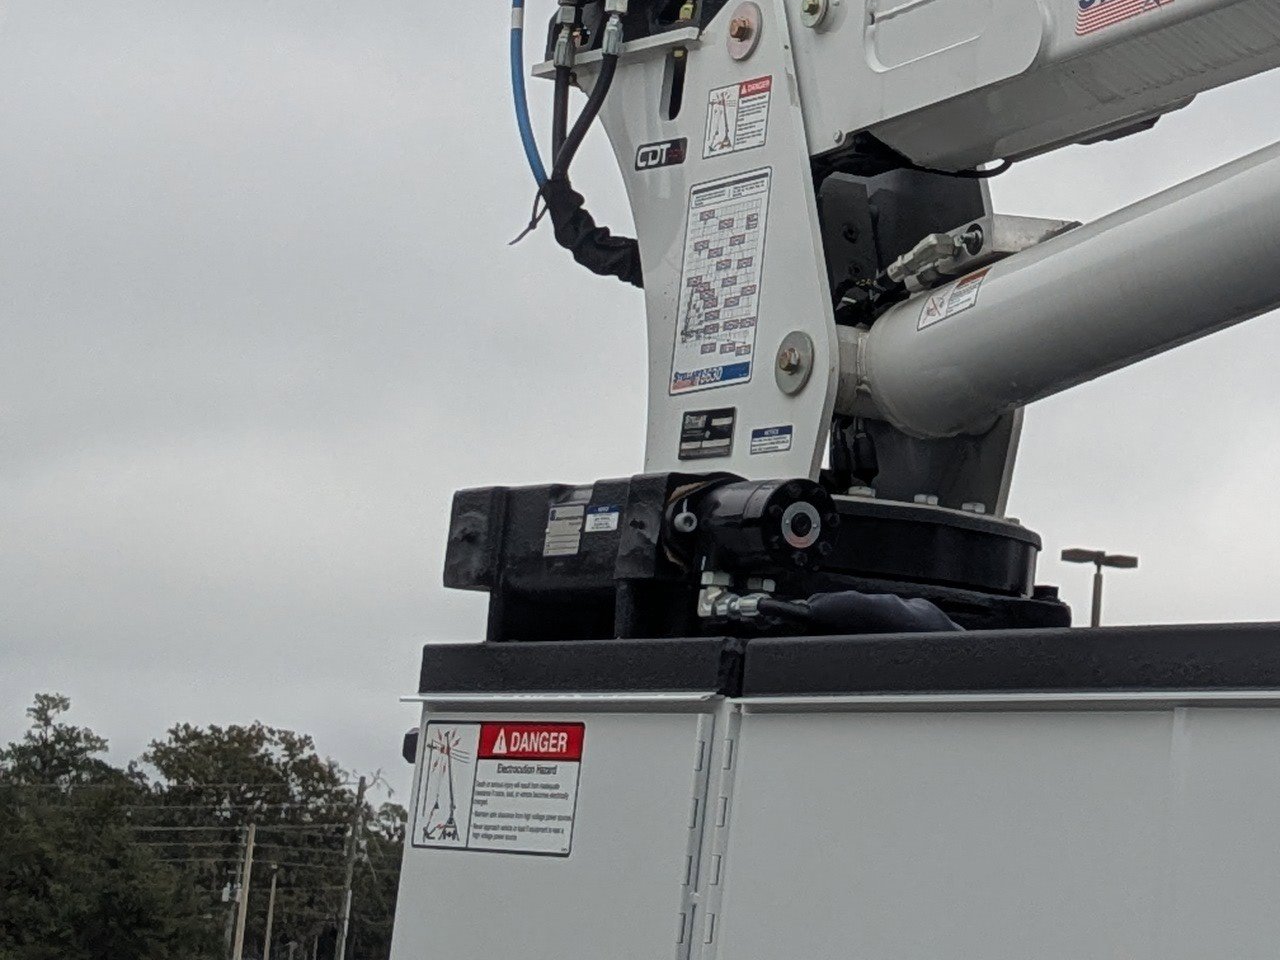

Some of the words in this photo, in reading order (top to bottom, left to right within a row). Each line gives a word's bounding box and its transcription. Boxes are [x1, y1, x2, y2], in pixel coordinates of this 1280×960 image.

[509, 731, 568, 753] DANGER
[497, 763, 535, 774] Electrocution
[536, 764, 558, 775] Hazard
